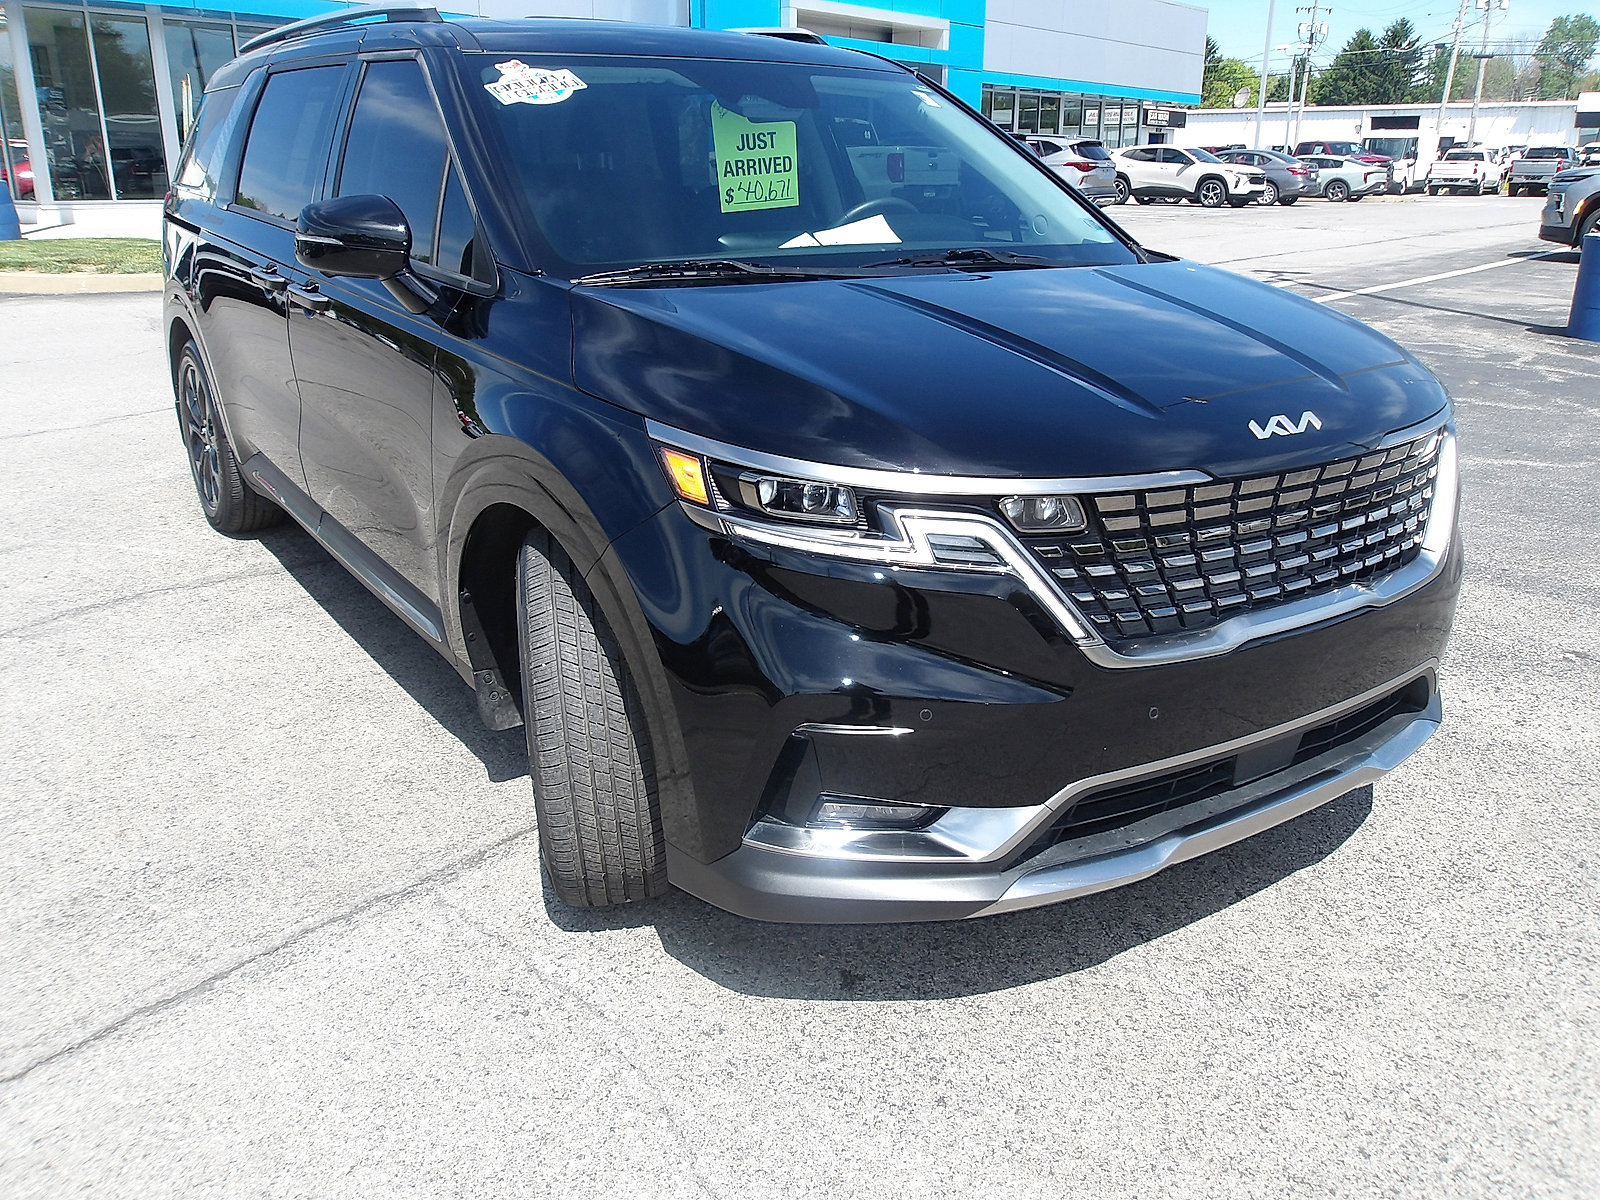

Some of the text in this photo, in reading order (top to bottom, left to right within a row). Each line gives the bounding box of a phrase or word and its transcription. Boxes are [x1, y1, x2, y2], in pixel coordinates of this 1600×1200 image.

[736, 132, 777, 151] JUST
[723, 156, 793, 177] ARRIVED
[1248, 411, 1322, 440] KIA
